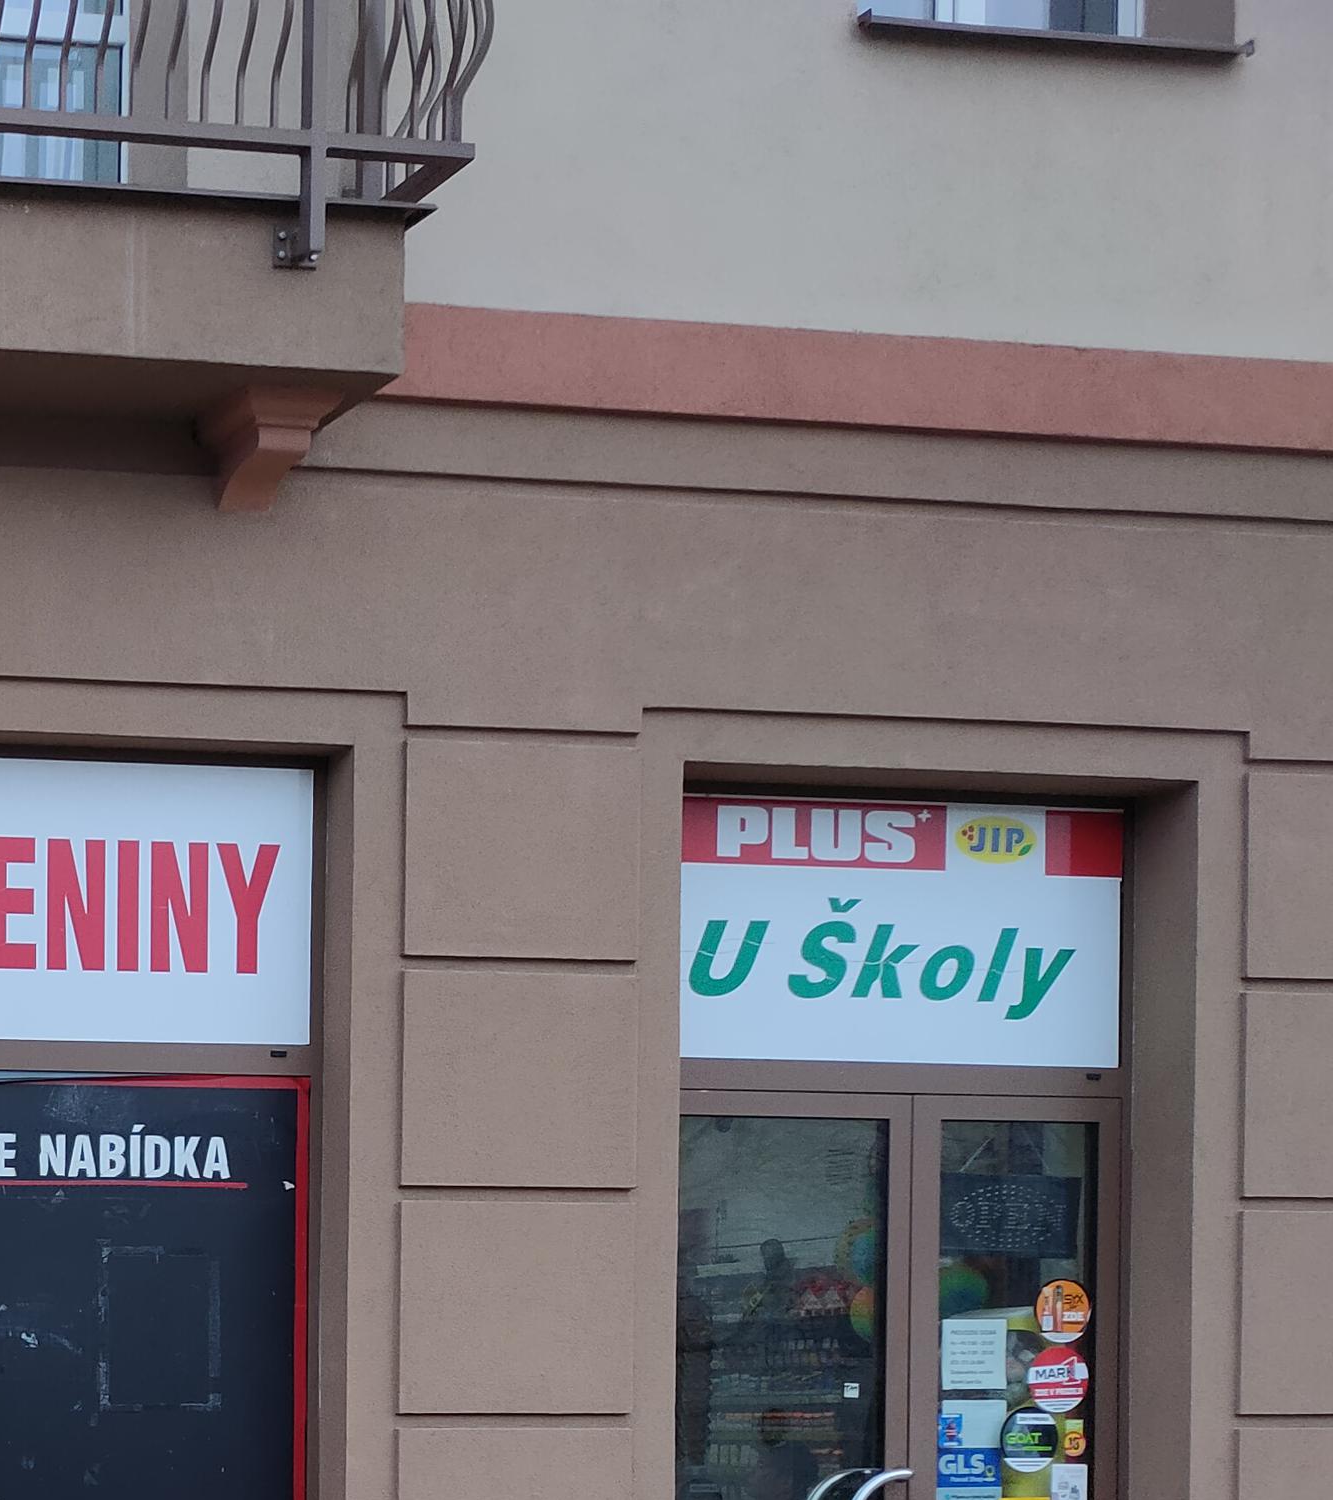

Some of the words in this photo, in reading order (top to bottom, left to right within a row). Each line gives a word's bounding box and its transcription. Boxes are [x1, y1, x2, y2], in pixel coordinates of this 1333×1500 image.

[968, 823, 1025, 855] JIP
[688, 920, 770, 997] U
[787, 898, 1077, 1021] Školy
[39, 1124, 231, 1180] NABÍDKA
[950, 1201, 1067, 1231] OPEN
